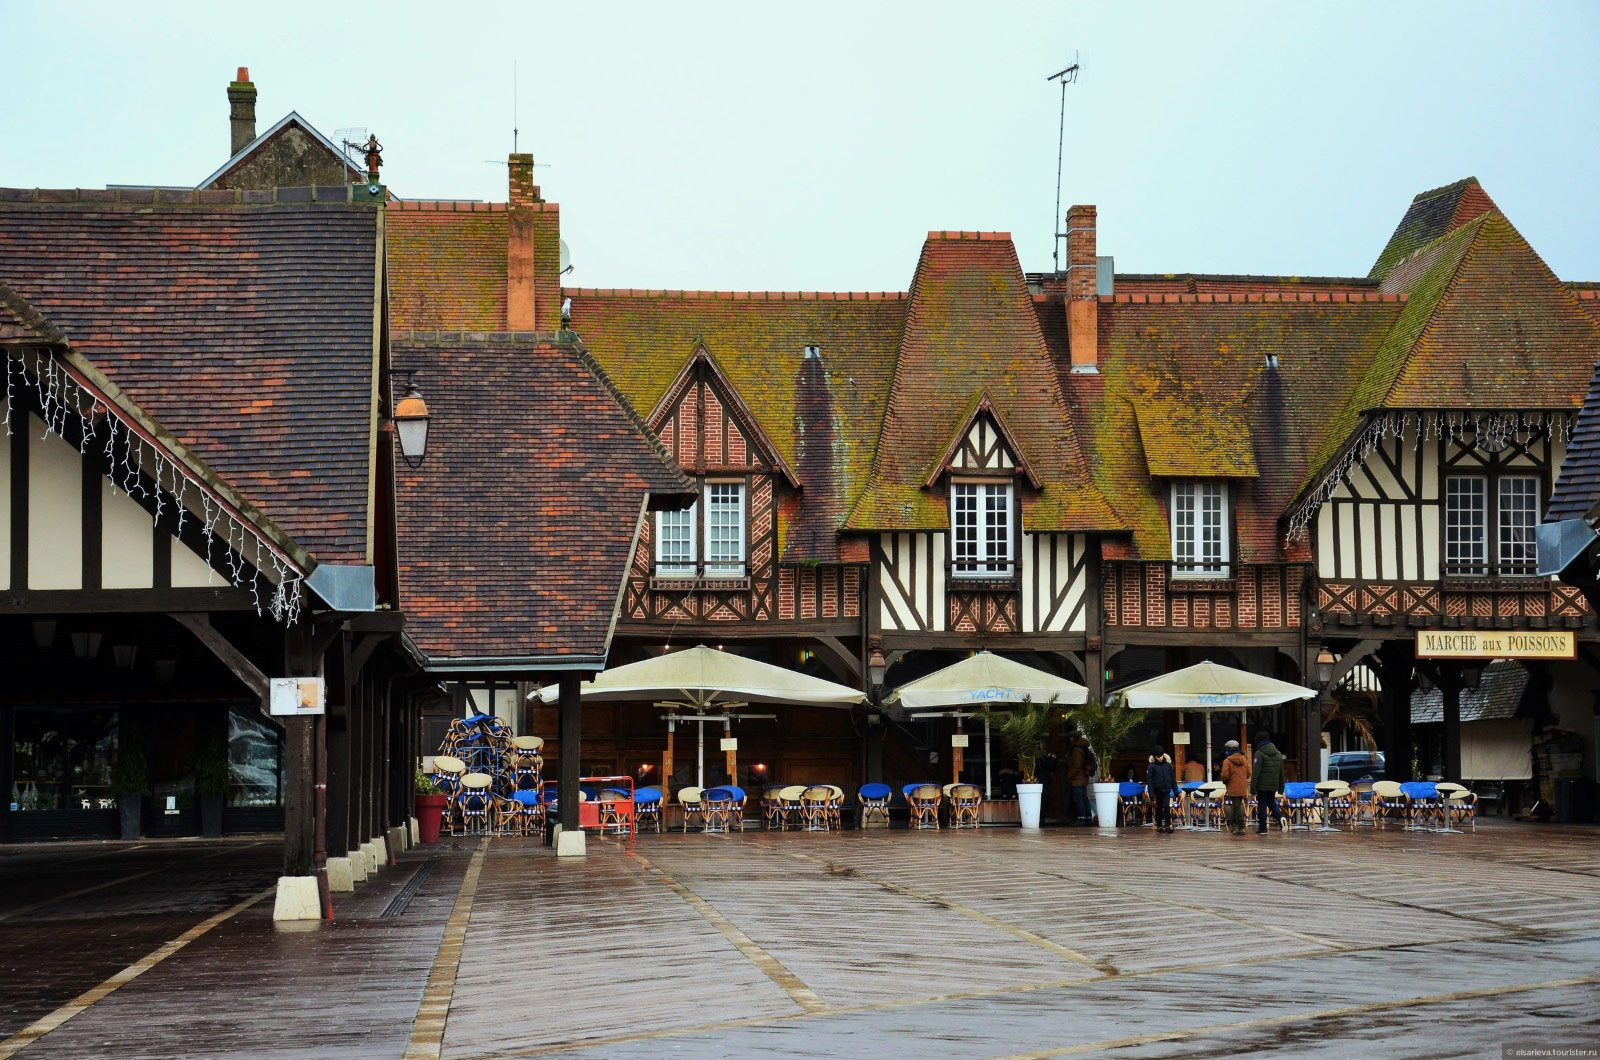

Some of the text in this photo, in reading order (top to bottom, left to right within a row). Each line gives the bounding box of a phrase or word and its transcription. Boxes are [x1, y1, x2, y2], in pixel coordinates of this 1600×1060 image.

[1425, 633, 1566, 651] MARCHÉ aux POISSONS
[969, 688, 1014, 700] YACHT
[1197, 694, 1242, 704] YACHT
